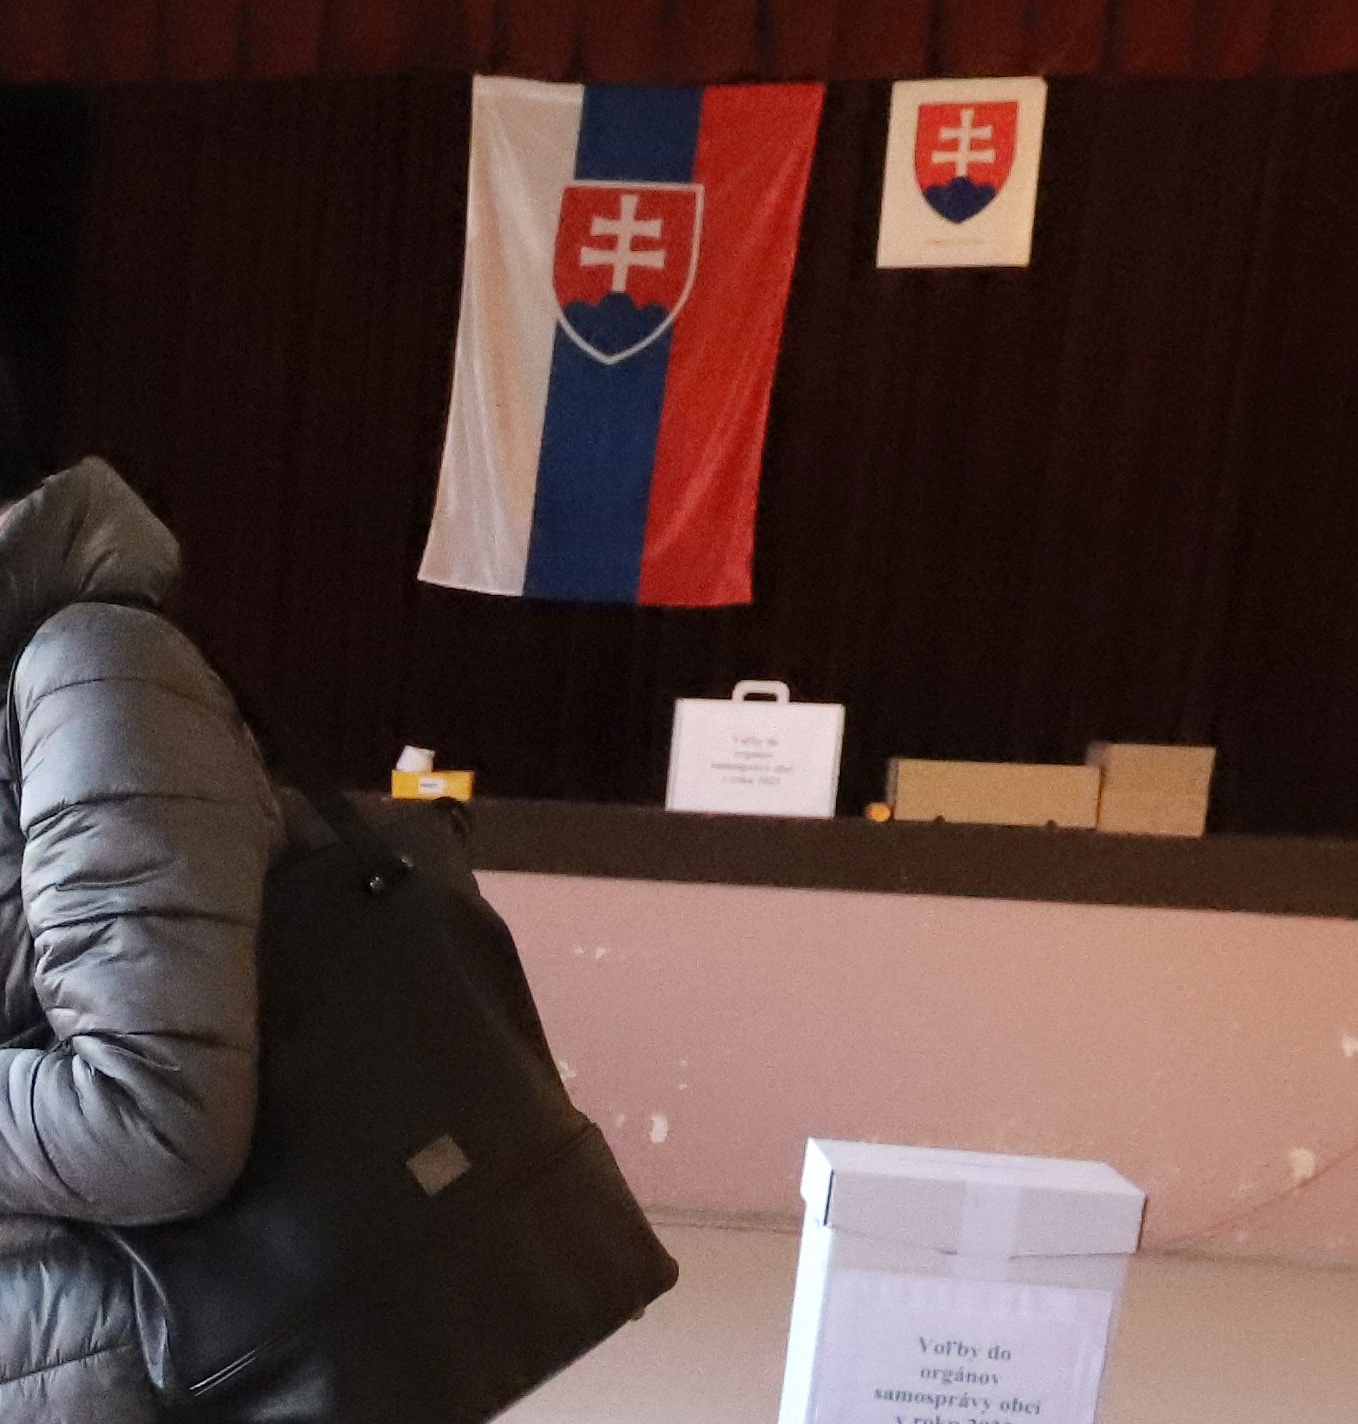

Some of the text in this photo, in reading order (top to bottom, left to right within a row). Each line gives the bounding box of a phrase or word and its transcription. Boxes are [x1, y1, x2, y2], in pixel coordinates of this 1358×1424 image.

[987, 1344, 1012, 1361] do
[920, 1366, 999, 1386] orgánov
[873, 1388, 991, 1414] samosprávy
